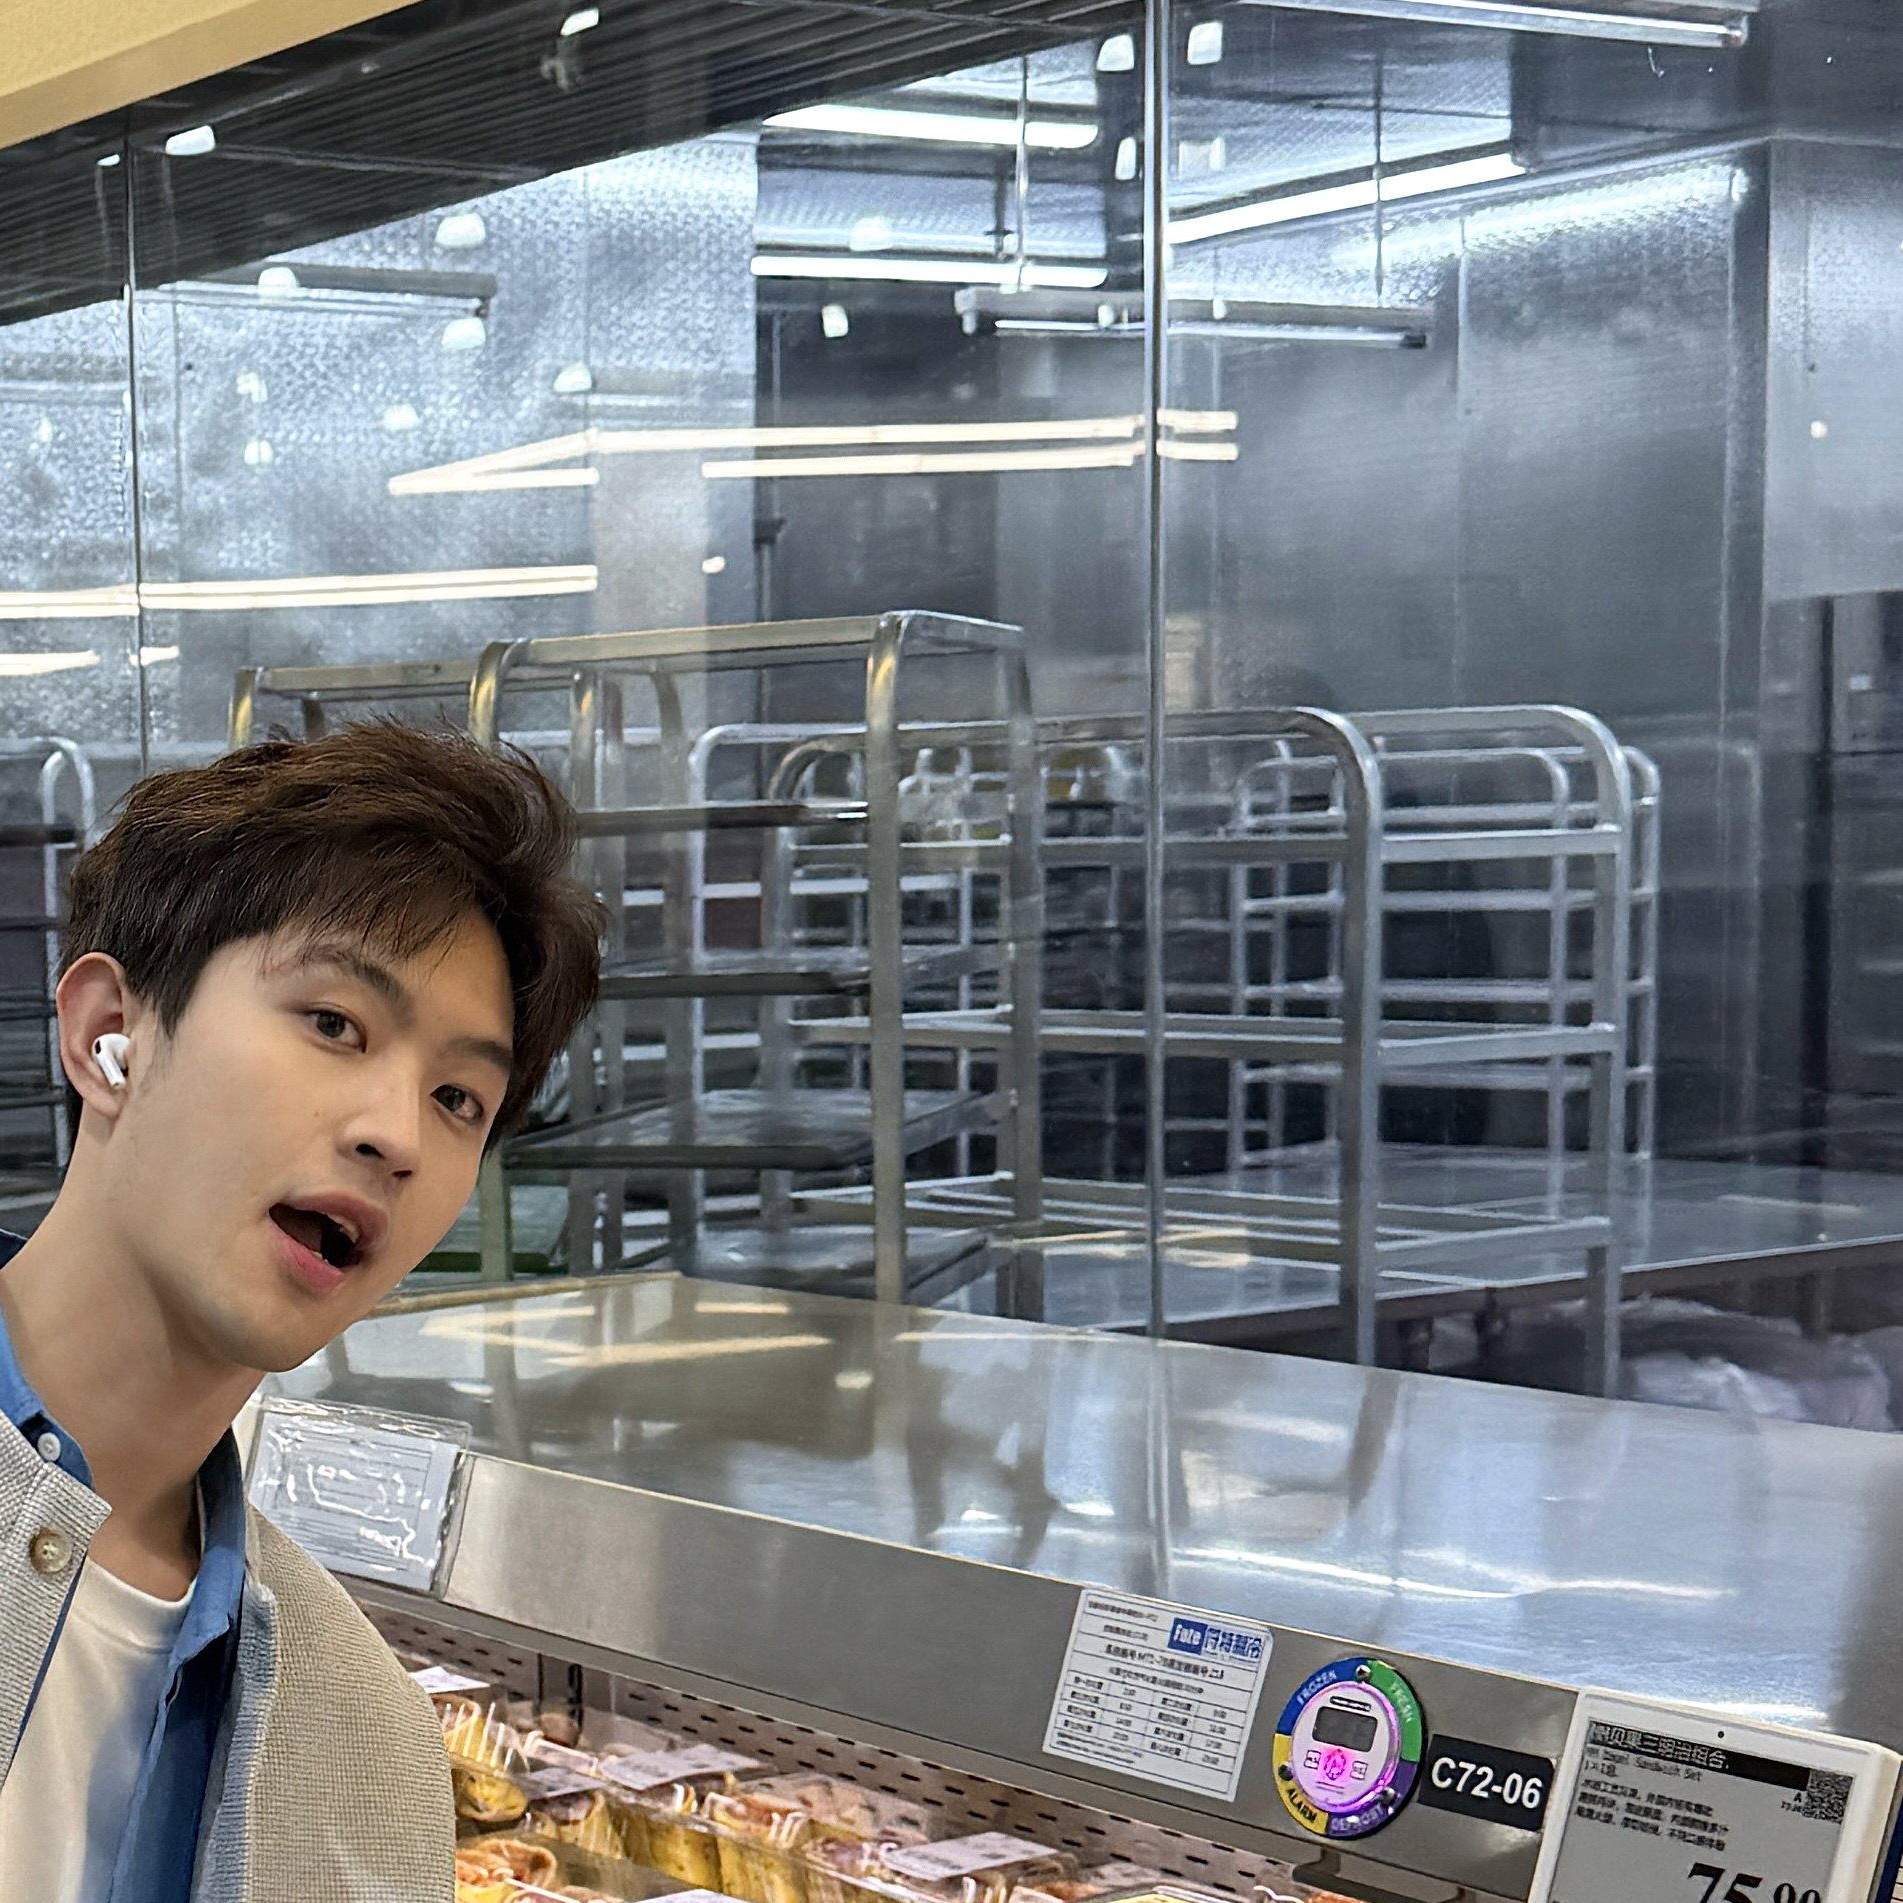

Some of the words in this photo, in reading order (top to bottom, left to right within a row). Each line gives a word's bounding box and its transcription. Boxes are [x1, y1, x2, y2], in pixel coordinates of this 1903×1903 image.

[1297, 1670, 1337, 1704] FROZEN
[1430, 1756, 1543, 1810] C72-06
[1285, 1787, 1317, 1823] ALARM
